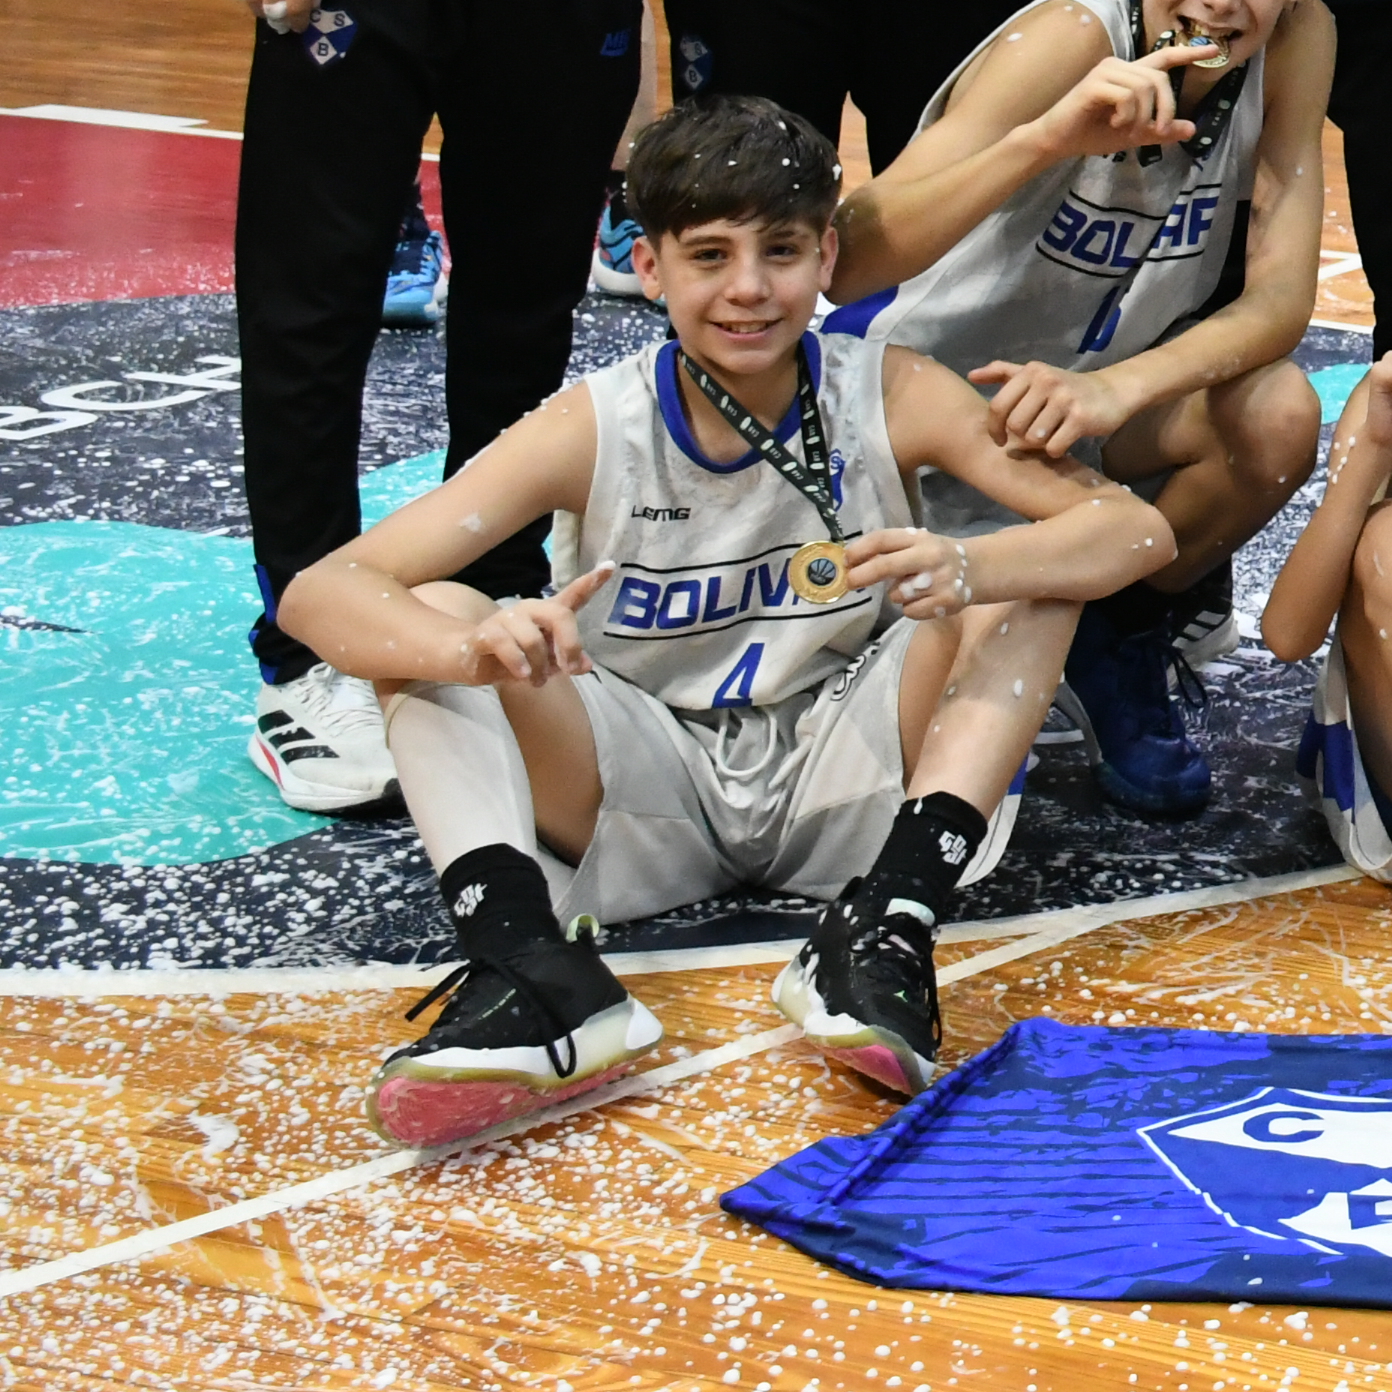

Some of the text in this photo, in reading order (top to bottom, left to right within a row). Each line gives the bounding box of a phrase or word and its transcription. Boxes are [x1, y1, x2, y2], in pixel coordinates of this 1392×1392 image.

[333, 12, 347, 28] S
[316, 41, 330, 58] B
[607, 557, 802, 629] BOLIV
[711, 642, 765, 709] 4
[1242, 1110, 1325, 1145] C
